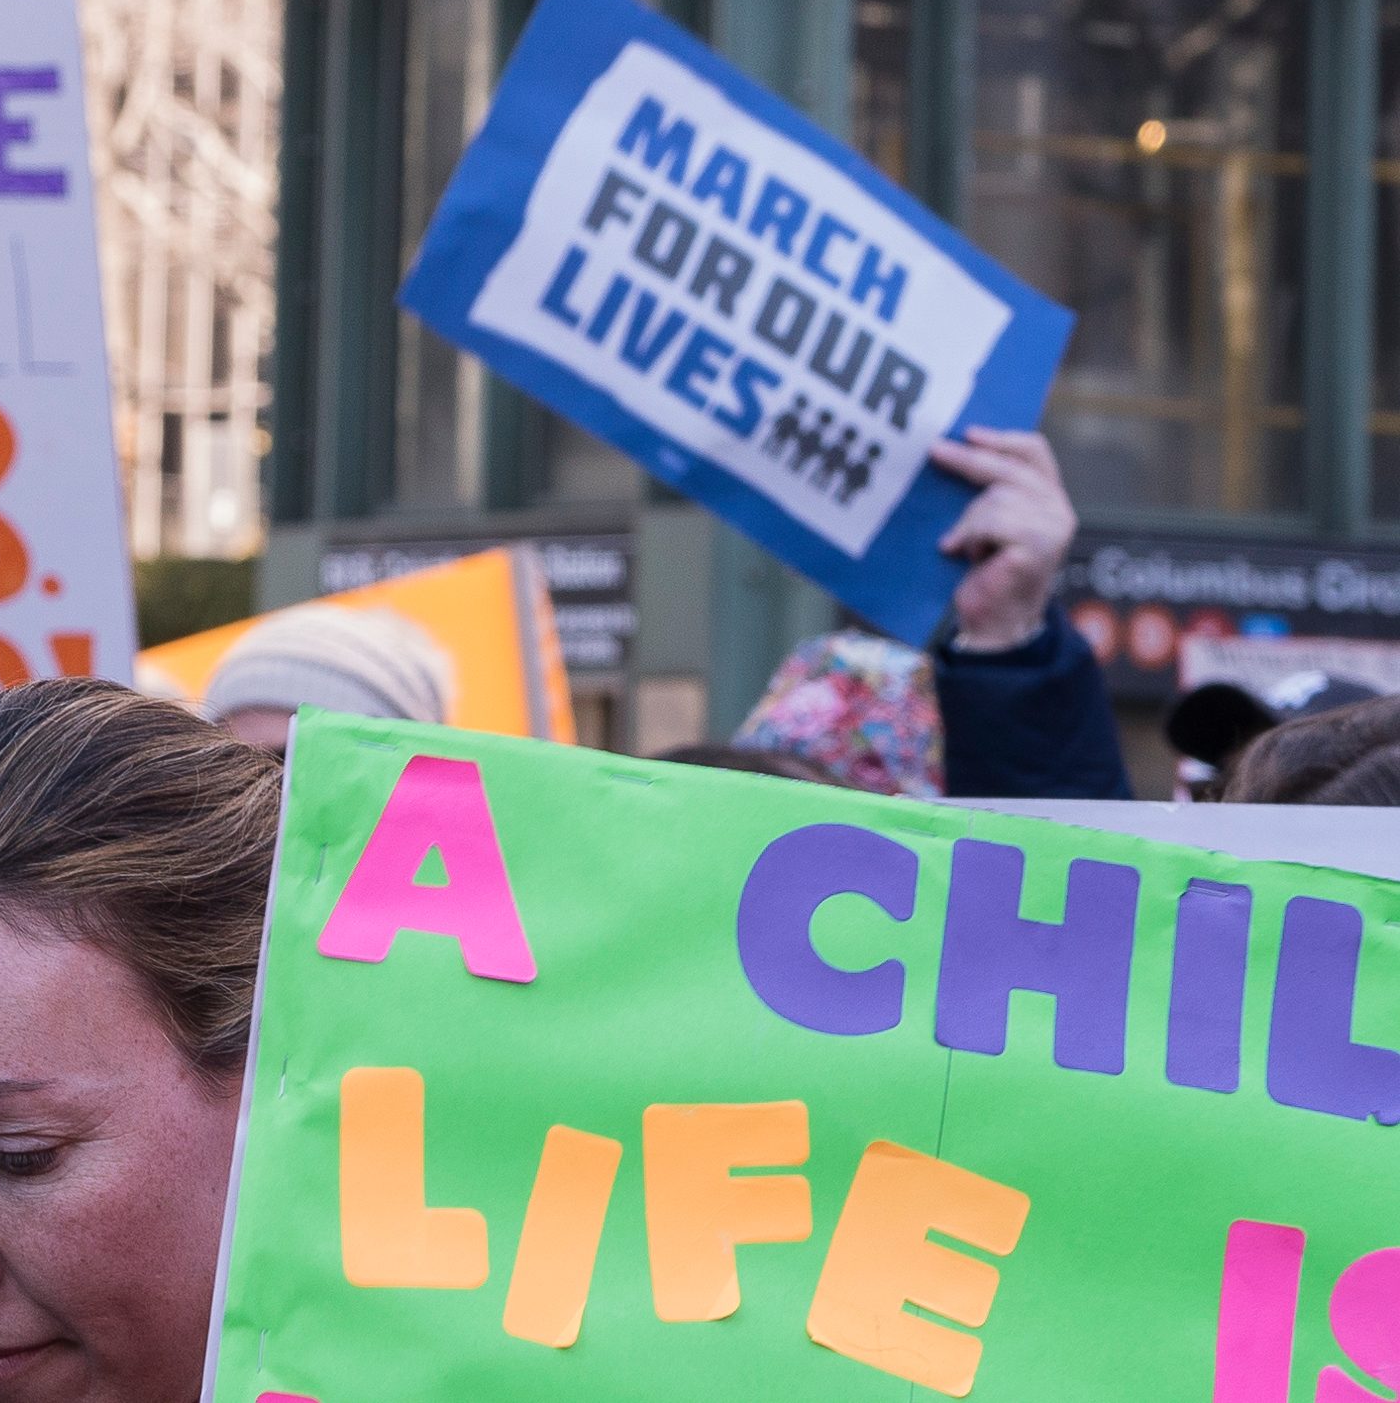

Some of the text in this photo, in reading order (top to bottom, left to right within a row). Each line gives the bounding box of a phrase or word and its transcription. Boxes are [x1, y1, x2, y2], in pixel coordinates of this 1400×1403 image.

[584, 169, 928, 434] FOR OUR
[618, 95, 908, 323] MARCH
[540, 245, 783, 442] LIVES
[317, 755, 1400, 1126] A CHIL
[338, 1066, 1031, 1397] LIFE
